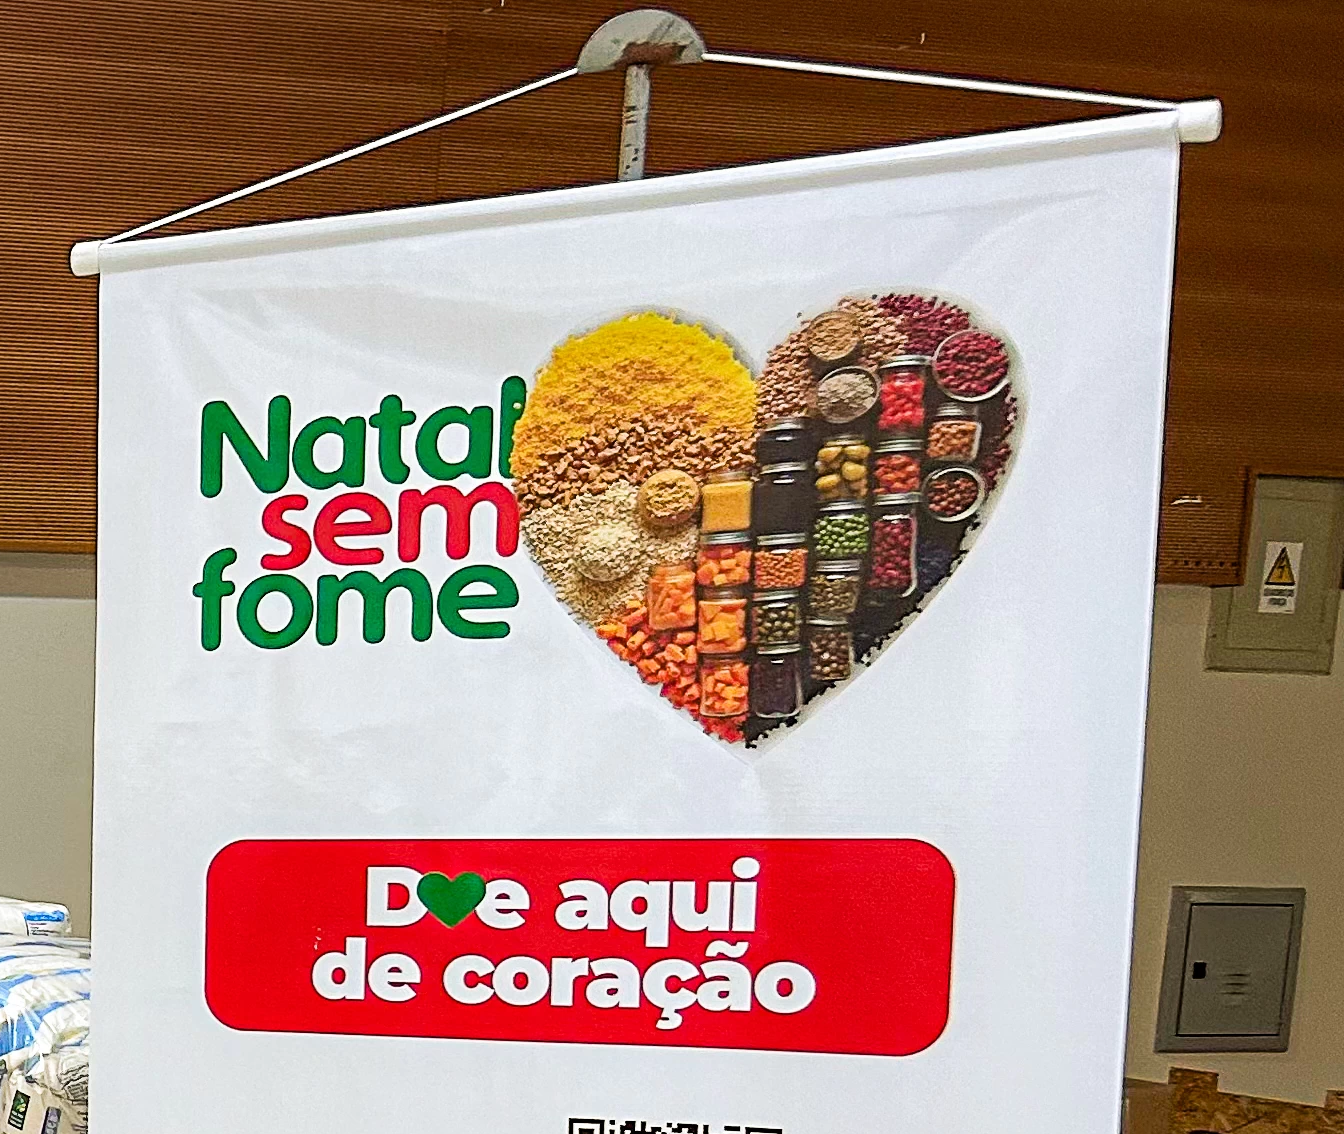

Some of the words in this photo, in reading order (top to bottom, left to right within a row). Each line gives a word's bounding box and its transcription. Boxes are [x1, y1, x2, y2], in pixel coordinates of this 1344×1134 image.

[200, 375, 528, 498] Natal
[261, 479, 519, 571] sem
[193, 546, 519, 651] fome
[366, 865, 531, 929] De
[556, 856, 758, 947] aqui
[312, 939, 420, 1002] de
[442, 941, 817, 1030] coração
